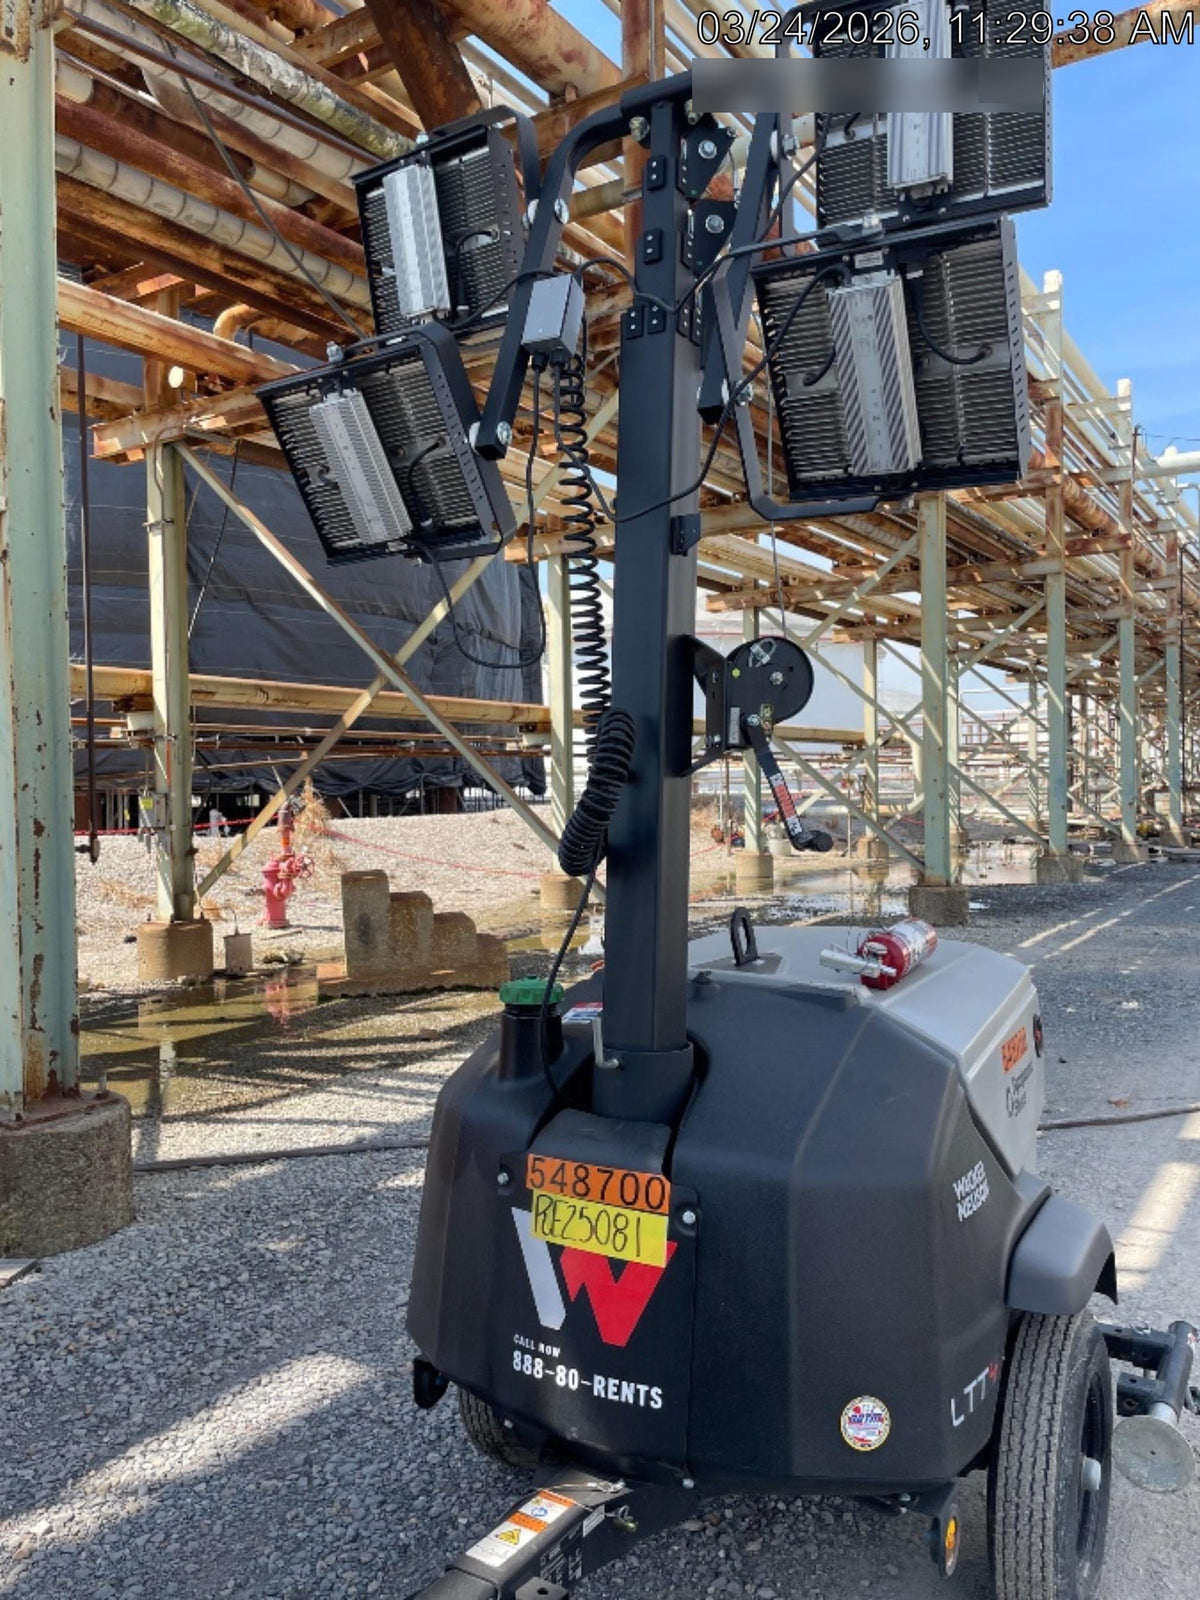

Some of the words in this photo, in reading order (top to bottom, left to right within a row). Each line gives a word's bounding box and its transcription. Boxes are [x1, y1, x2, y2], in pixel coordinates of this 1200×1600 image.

[530, 1157, 665, 1210] 548700
[534, 1194, 641, 1257] RE25081
[513, 1333, 536, 1351] CALL
[538, 1342, 561, 1358] NOW
[512, 1349, 664, 1410] 888-80-RENTS
